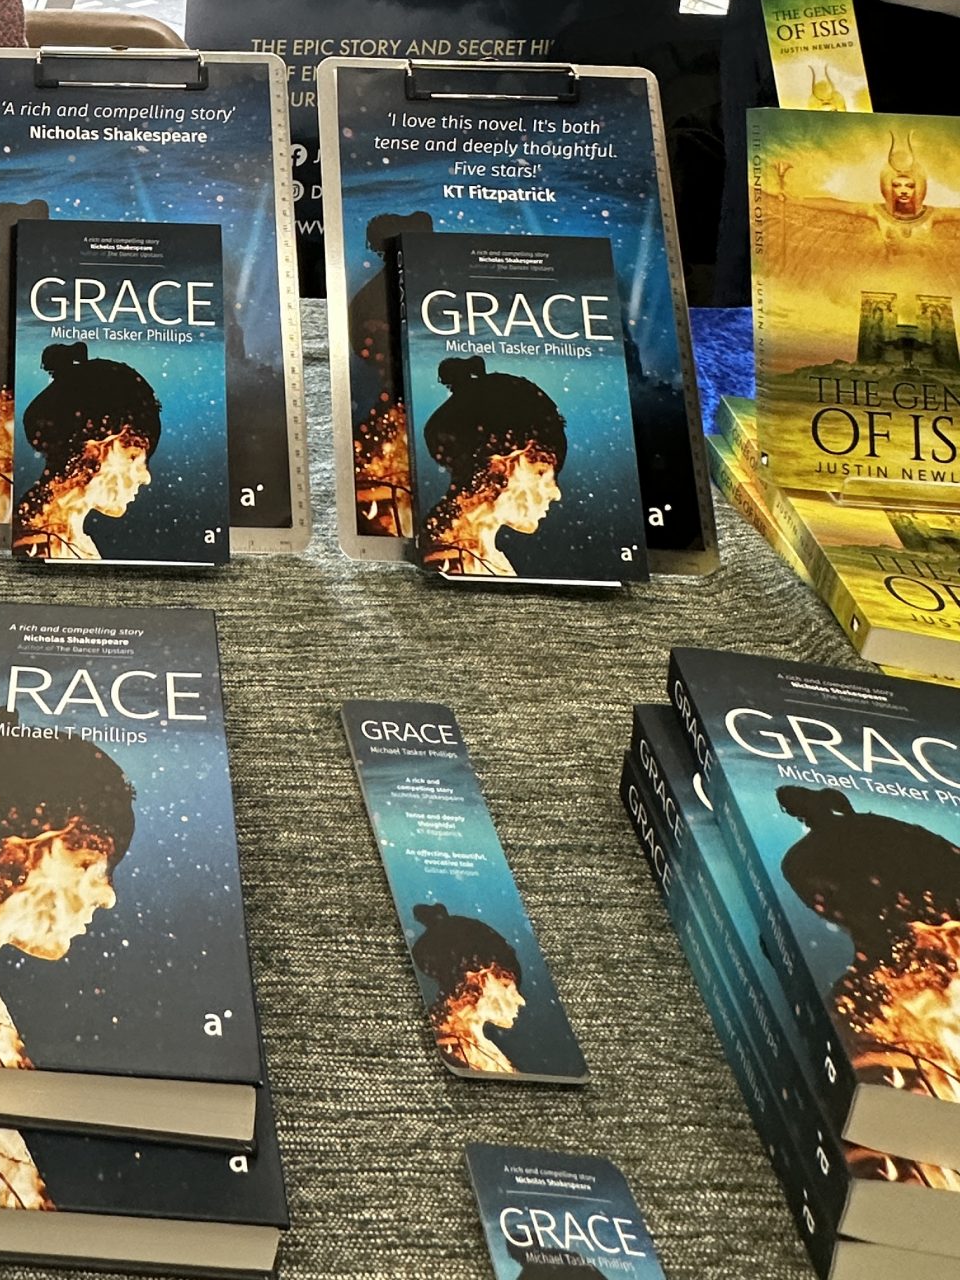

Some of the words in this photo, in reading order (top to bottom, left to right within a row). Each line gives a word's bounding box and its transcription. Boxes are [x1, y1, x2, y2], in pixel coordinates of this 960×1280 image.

[772, 8, 800, 22] THE
[803, 4, 847, 19] GENES
[776, 22, 807, 42] OF
[813, 18, 850, 38] ISIS
[251, 39, 287, 56] THE
[292, 39, 335, 56] EPIC
[340, 39, 402, 57] STORY
[406, 39, 451, 56] AND
[456, 39, 528, 57] SECRET
[530, 39, 554, 57] HI
[780, 44, 810, 55] JUSTIN
[812, 41, 854, 51] NEWLAND
[20, 102, 50, 117] rich
[57, 103, 88, 118] and
[94, 105, 185, 122] compelling
[402, 112, 436, 129] love
[441, 115, 472, 129] this
[478, 116, 527, 132] novel.
[532, 118, 558, 133] It's
[563, 119, 600, 134] both
[30, 126, 99, 141] Nicholas
[103, 127, 207, 144] Shakespeare
[374, 136, 420, 151] tense
[424, 137, 457, 152] and
[462, 139, 518, 157] deeply
[523, 142, 617, 160] thoughtful.
[454, 162, 487, 177] Five
[443, 185, 463, 198] KT
[469, 186, 556, 202] Fitzpatrick
[29, 277, 215, 326] GRACE
[421, 290, 614, 340] GRACE
[51, 326, 99, 339] Michael
[103, 328, 142, 341] Tasker
[147, 329, 192, 344] Phillips
[446, 340, 496, 353] Michael
[499, 342, 540, 355] Tasker
[544, 343, 592, 358] Phillips
[809, 376, 882, 408] THE
[811, 407, 893, 458] OF
[815, 462, 888, 479] JUSTIN
[9, 623, 17, 631] A
[19, 624, 38, 632] rich
[40, 625, 59, 633] and
[62, 626, 117, 636] compelling
[119, 628, 144, 637] story
[23, 634, 65, 644] Nicholas
[67, 636, 129, 646] Shakespeare
[56, 645, 70, 653] The
[72, 646, 100, 655] Dancer
[102, 647, 135, 656] Upstairs
[64, 726, 76, 740] T
[81, 727, 148, 744] Phillips
[361, 720, 458, 745] GRACE
[675, 680, 712, 781] GRACE
[370, 746, 400, 756] Michael
[402, 748, 427, 757] Tasker
[428, 749, 458, 760] Phillips
[778, 764, 858, 790] Michael
[861, 777, 929, 800] Tasker
[640, 739, 682, 848] GRACE
[629, 785, 670, 896] GRACE
[500, 1207, 646, 1257] GRACE
[526, 1252, 563, 1263] Michael
